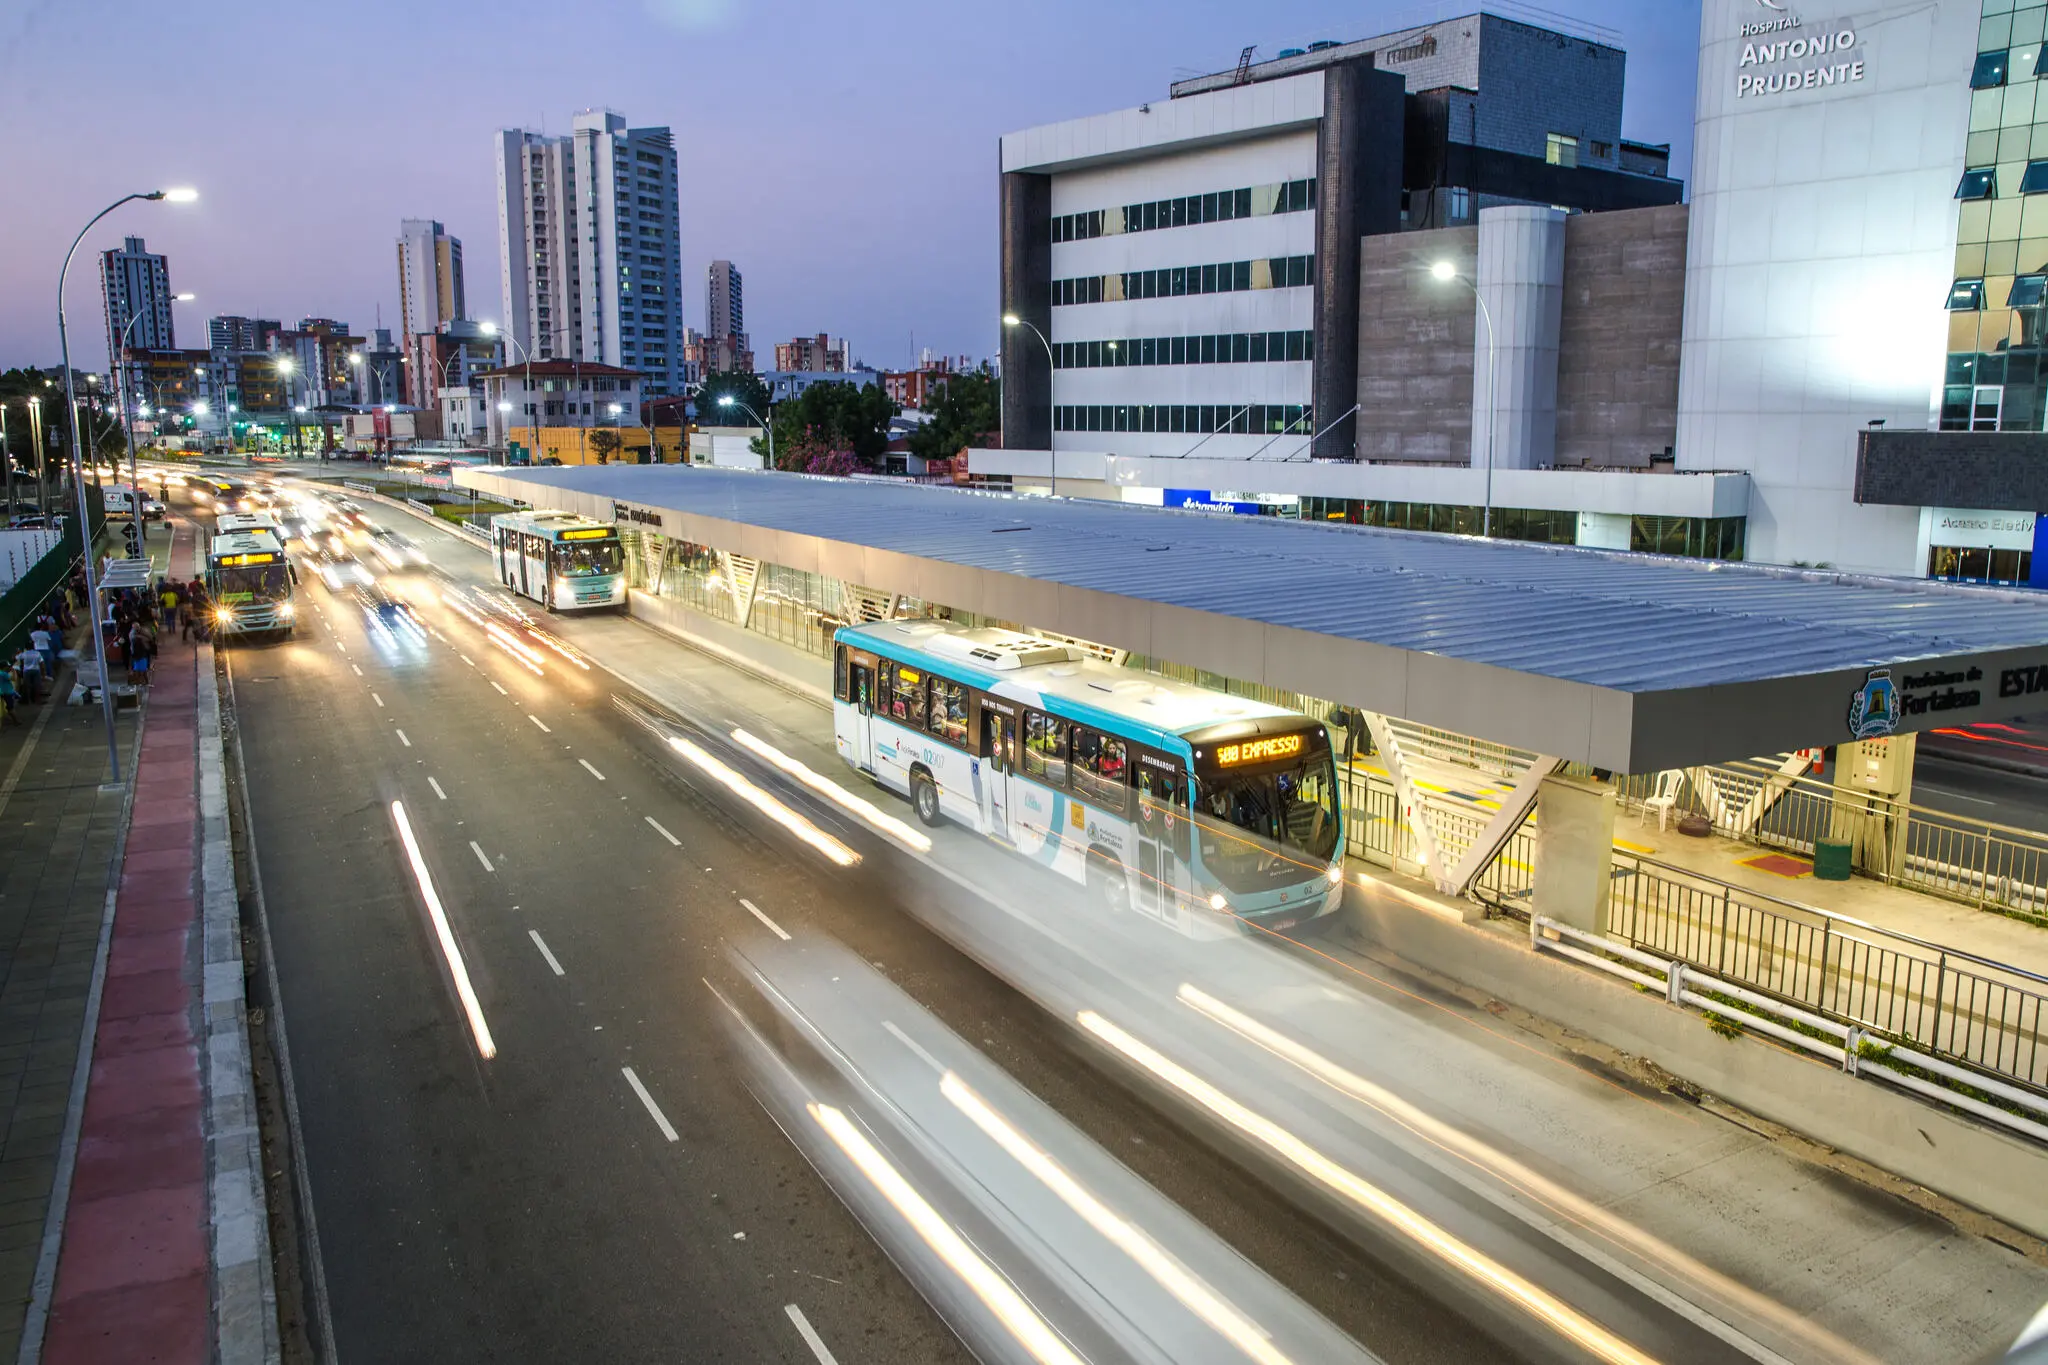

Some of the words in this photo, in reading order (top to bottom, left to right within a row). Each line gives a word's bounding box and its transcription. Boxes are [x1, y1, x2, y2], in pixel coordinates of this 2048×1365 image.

[1740, 16, 1801, 37] HOSPITAL
[1739, 30, 1856, 68] ANTONIO
[1737, 61, 1864, 98] PRUDENTE
[1991, 518, 2036, 532] Eletiv
[1966, 666, 1983, 682] de
[1901, 687, 1982, 717] Fortaleza
[1242, 734, 1299, 760] EXPRESSO
[1141, 754, 1175, 773] DESEMBARQUE
